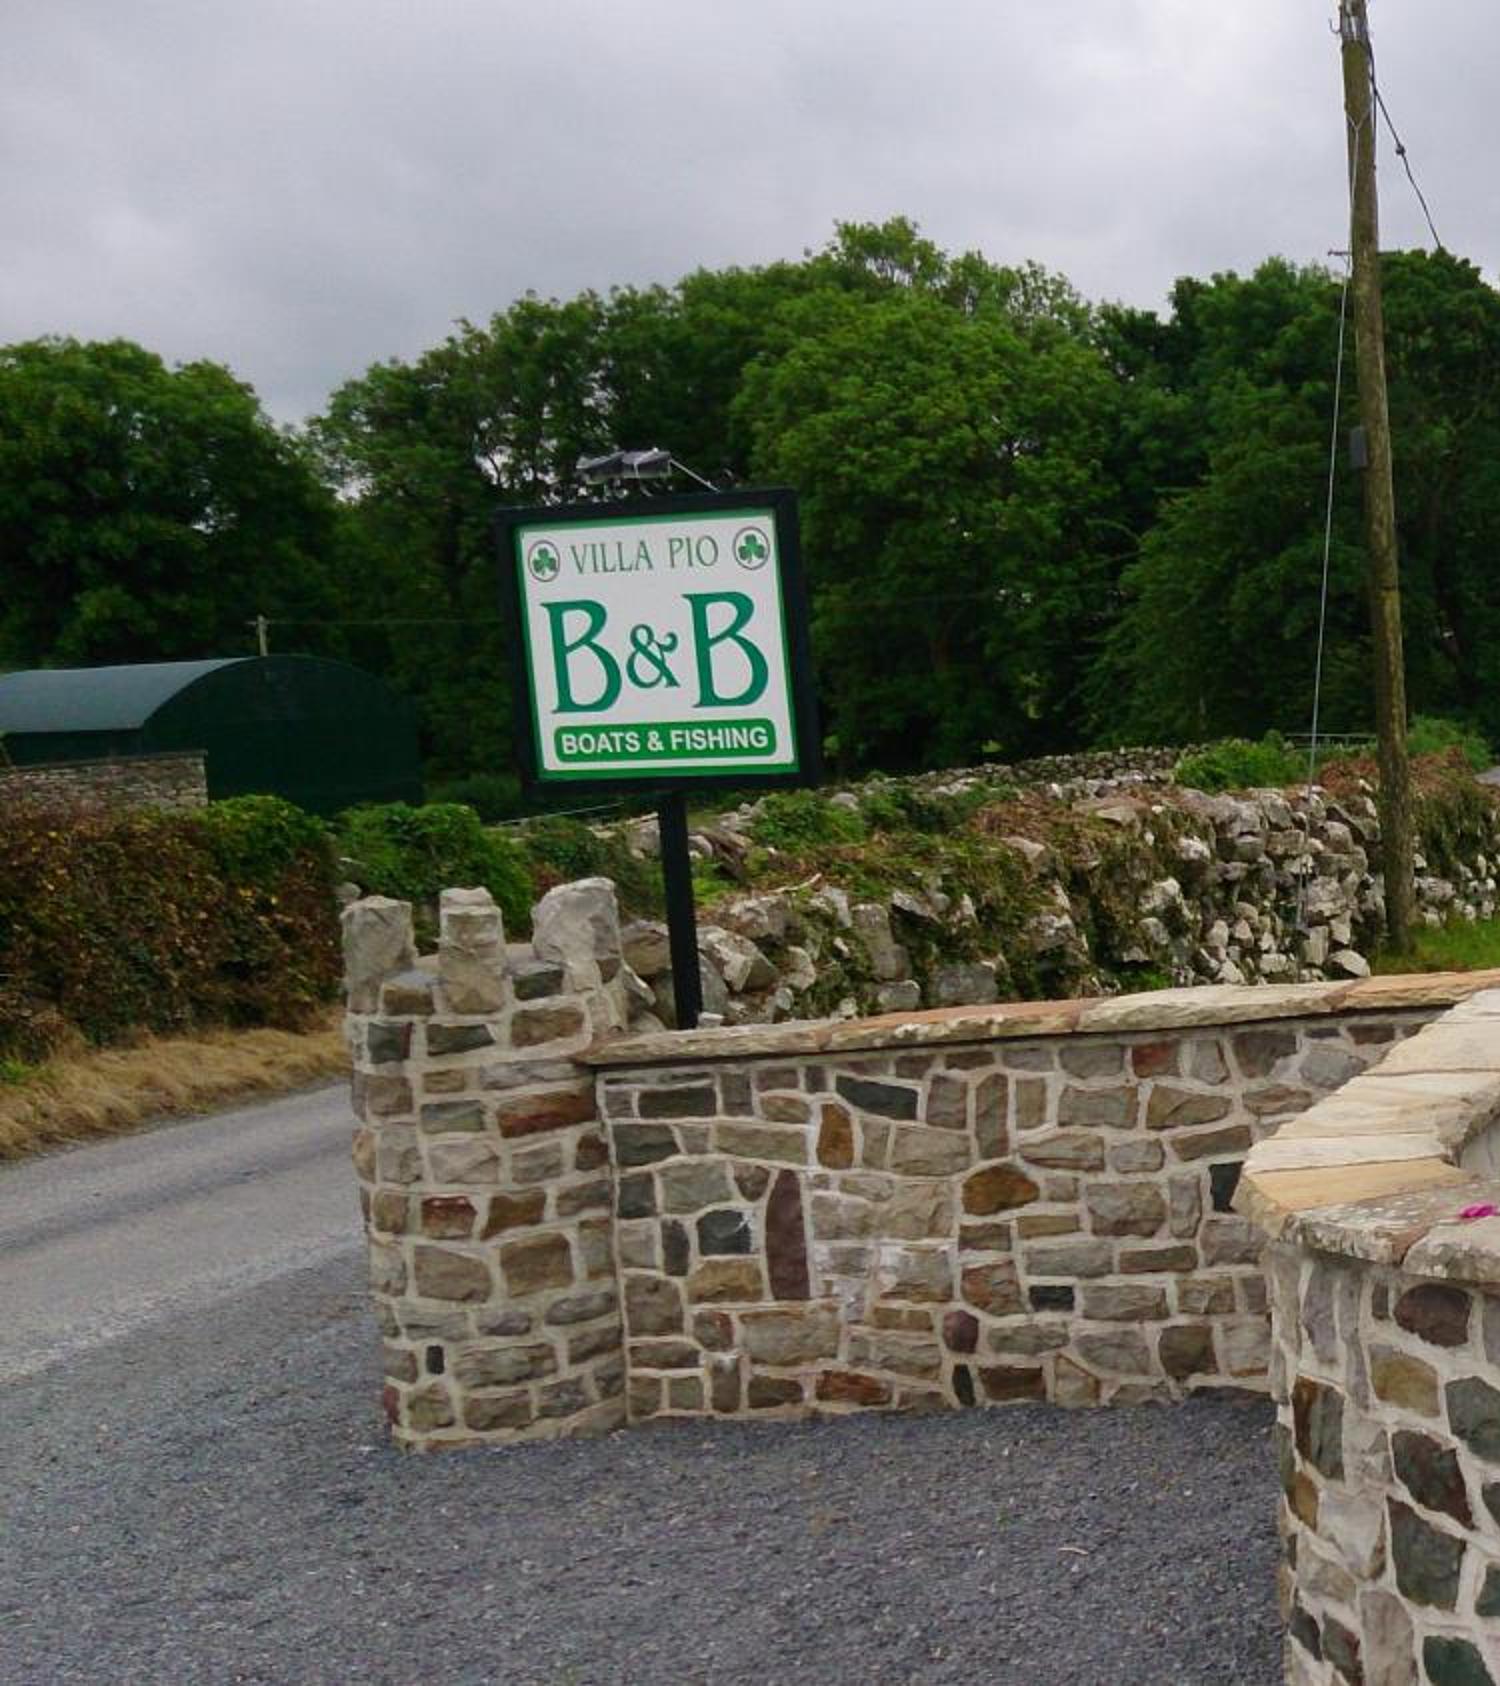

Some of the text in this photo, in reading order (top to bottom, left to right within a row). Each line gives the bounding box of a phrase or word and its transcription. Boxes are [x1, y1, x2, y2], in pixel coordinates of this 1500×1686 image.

[570, 535, 719, 574] VILLA PIO
[540, 591, 769, 714] B&B
[561, 727, 768, 754] BOATS & FISHING
